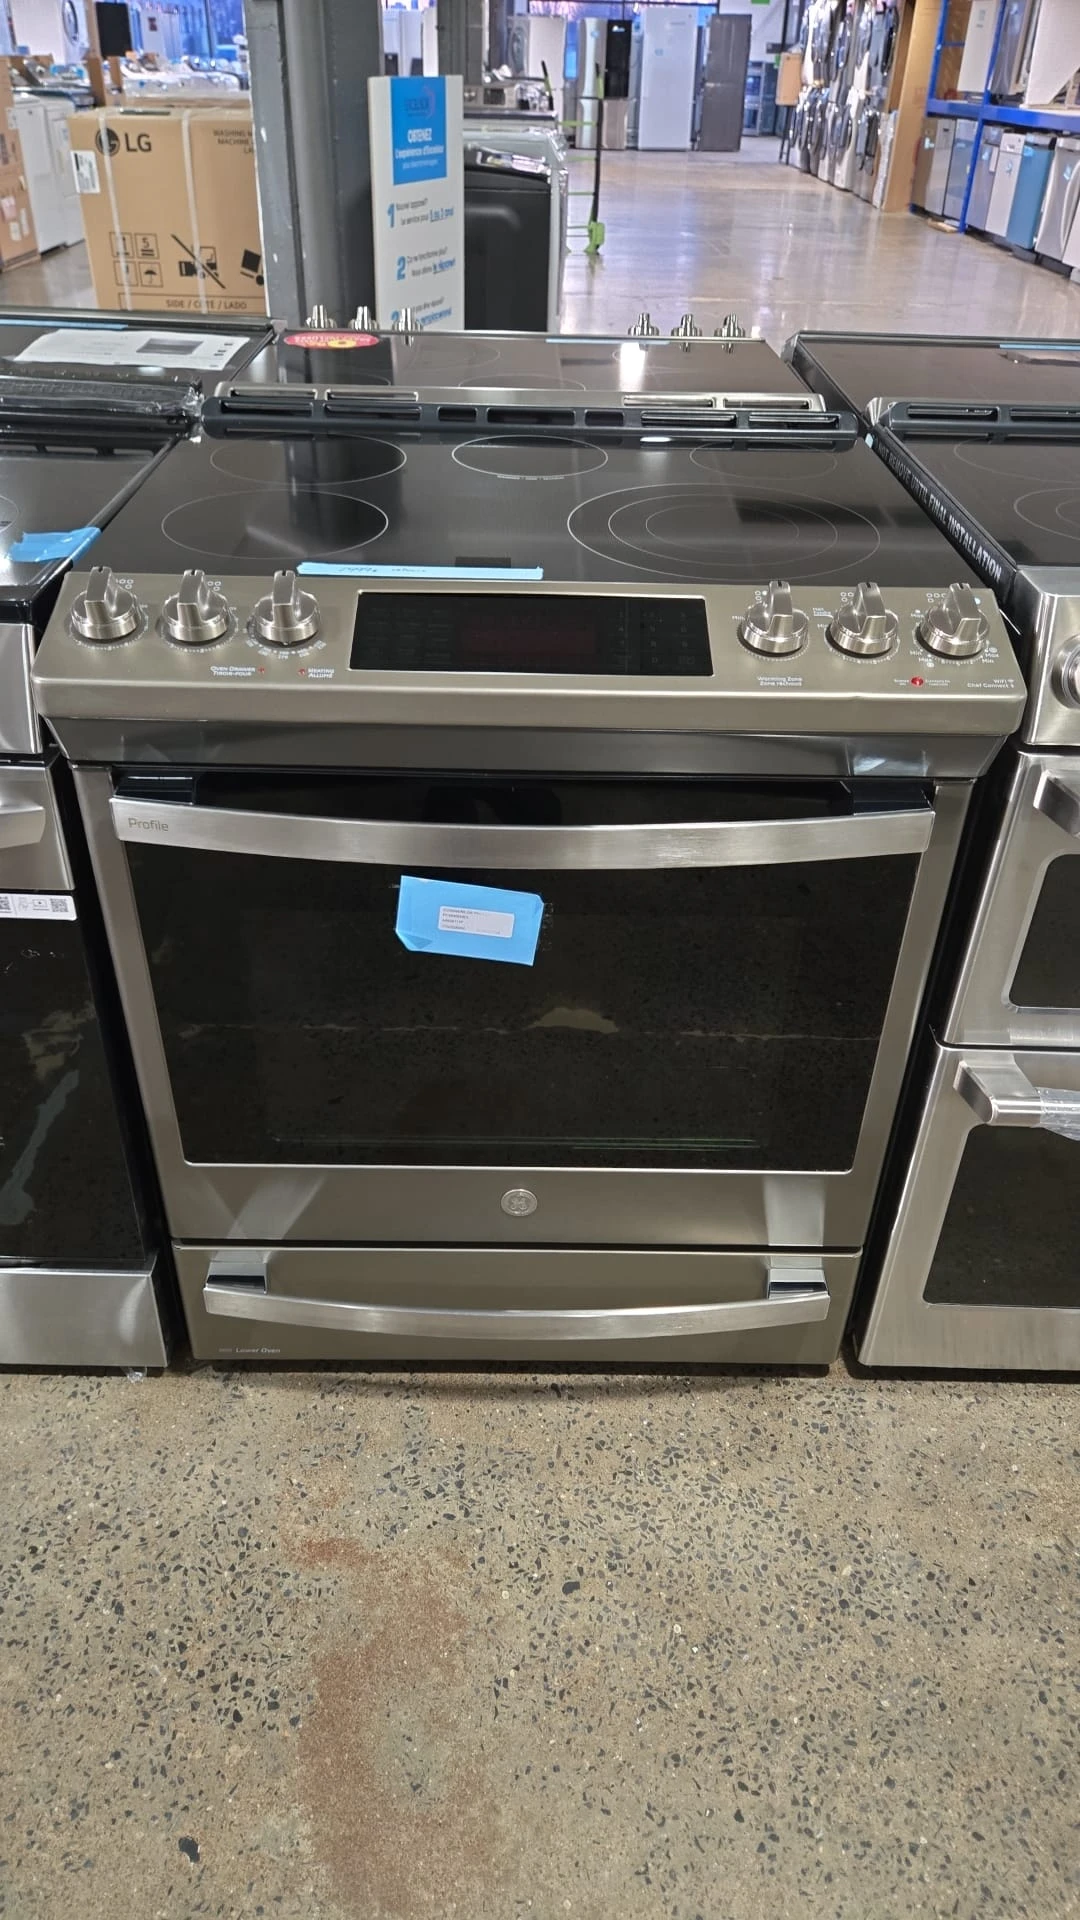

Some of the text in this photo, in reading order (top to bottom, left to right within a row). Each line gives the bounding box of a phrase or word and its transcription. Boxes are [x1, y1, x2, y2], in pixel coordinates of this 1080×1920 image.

[213, 129, 246, 137] WASHING
[124, 132, 152, 152] LG
[387, 203, 396, 228] 1
[142, 237, 150, 249] 5
[397, 255, 406, 280] 2
[166, 299, 185, 308] SIDE
[224, 301, 247, 310] LADO
[889, 452, 911, 485] REMOVE
[911, 473, 928, 503] UNTIL
[929, 493, 947, 524] FINAL
[948, 515, 1002, 582] INSTALLATION
[128, 817, 169, 831] Profile
